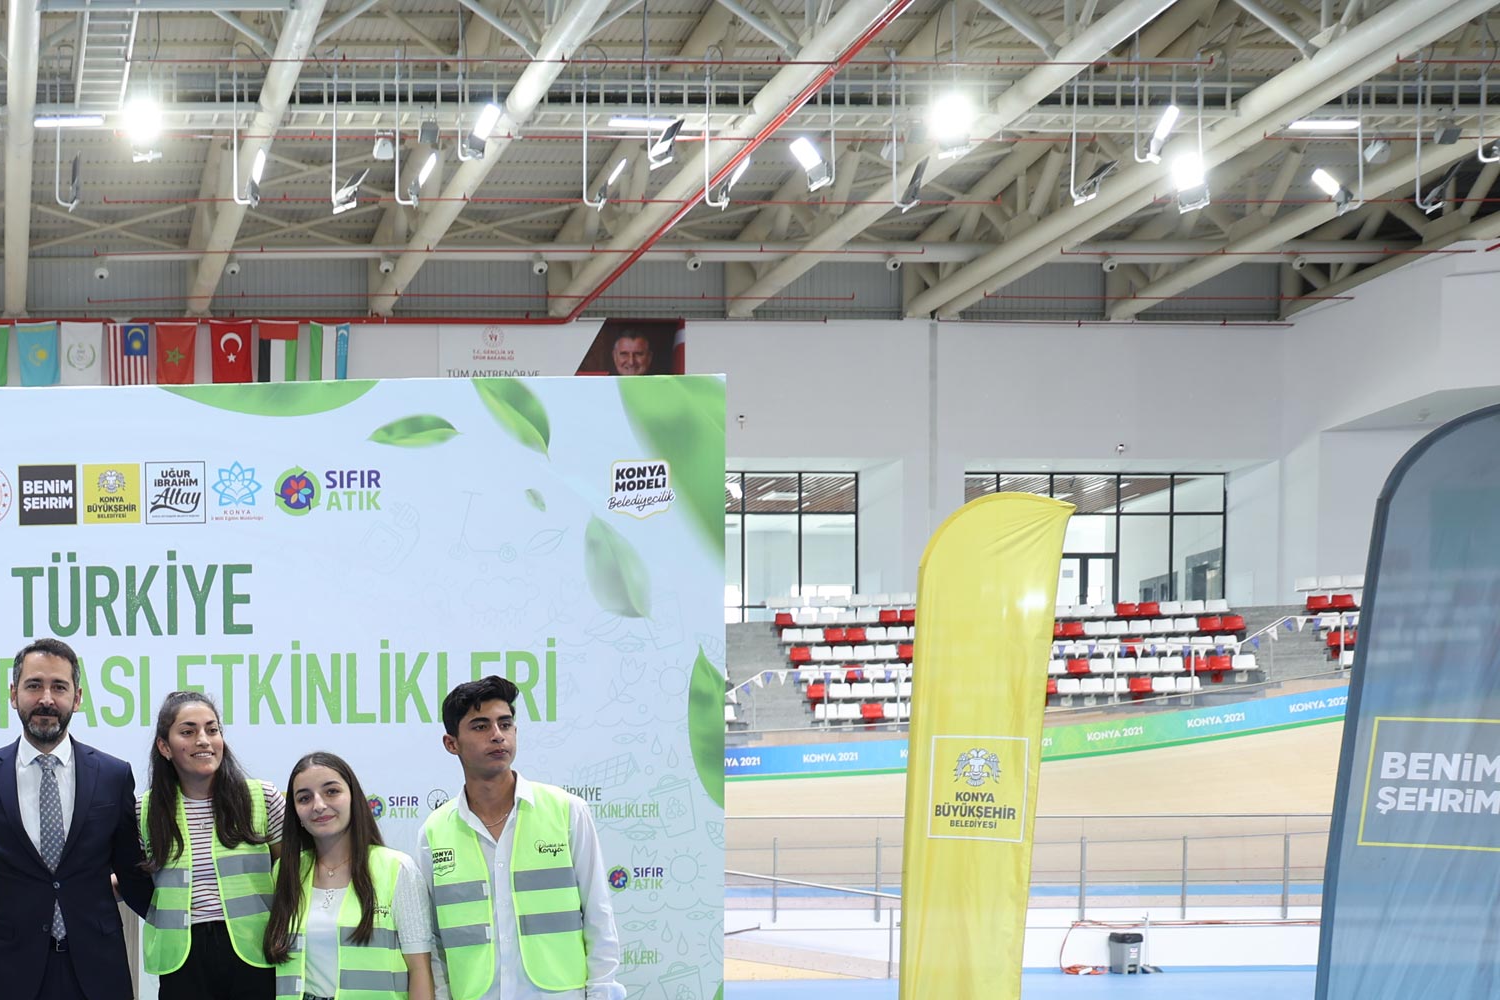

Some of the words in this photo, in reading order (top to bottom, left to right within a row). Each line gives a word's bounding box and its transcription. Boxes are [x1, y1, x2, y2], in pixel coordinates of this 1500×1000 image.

[446, 368, 470, 378] TÜM
[161, 468, 191, 478] UĞUR
[615, 464, 667, 480] KONYA
[325, 469, 381, 489] SIFIR
[150, 487, 202, 514] Altay
[326, 489, 381, 511] ATIK
[607, 489, 675, 512] Belediyecilik
[87, 503, 137, 514] BÜYÜKŞEHİR
[11, 550, 254, 638] TÜRKİYE
[1289, 699, 1326, 713] KONYA
[1186, 715, 1222, 729] KONYA
[1224, 712, 1246, 724] 2021
[1086, 728, 1122, 742] KONYA
[1122, 725, 1144, 738] 2021
[740, 756, 761, 767] 2021
[803, 752, 837, 764] KONYA
[838, 751, 860, 762] 2021
[388, 795, 419, 807] SIFIR
[955, 791, 995, 803] KONYA
[389, 807, 419, 819] ATIK
[589, 801, 659, 819] TKİNLİKLERİ
[934, 802, 1017, 820] BÜYÜKŞEHİR
[949, 819, 998, 829] BELEDİYESİ
[633, 867, 664, 878] SIFIR
[634, 878, 664, 890] ATIK
